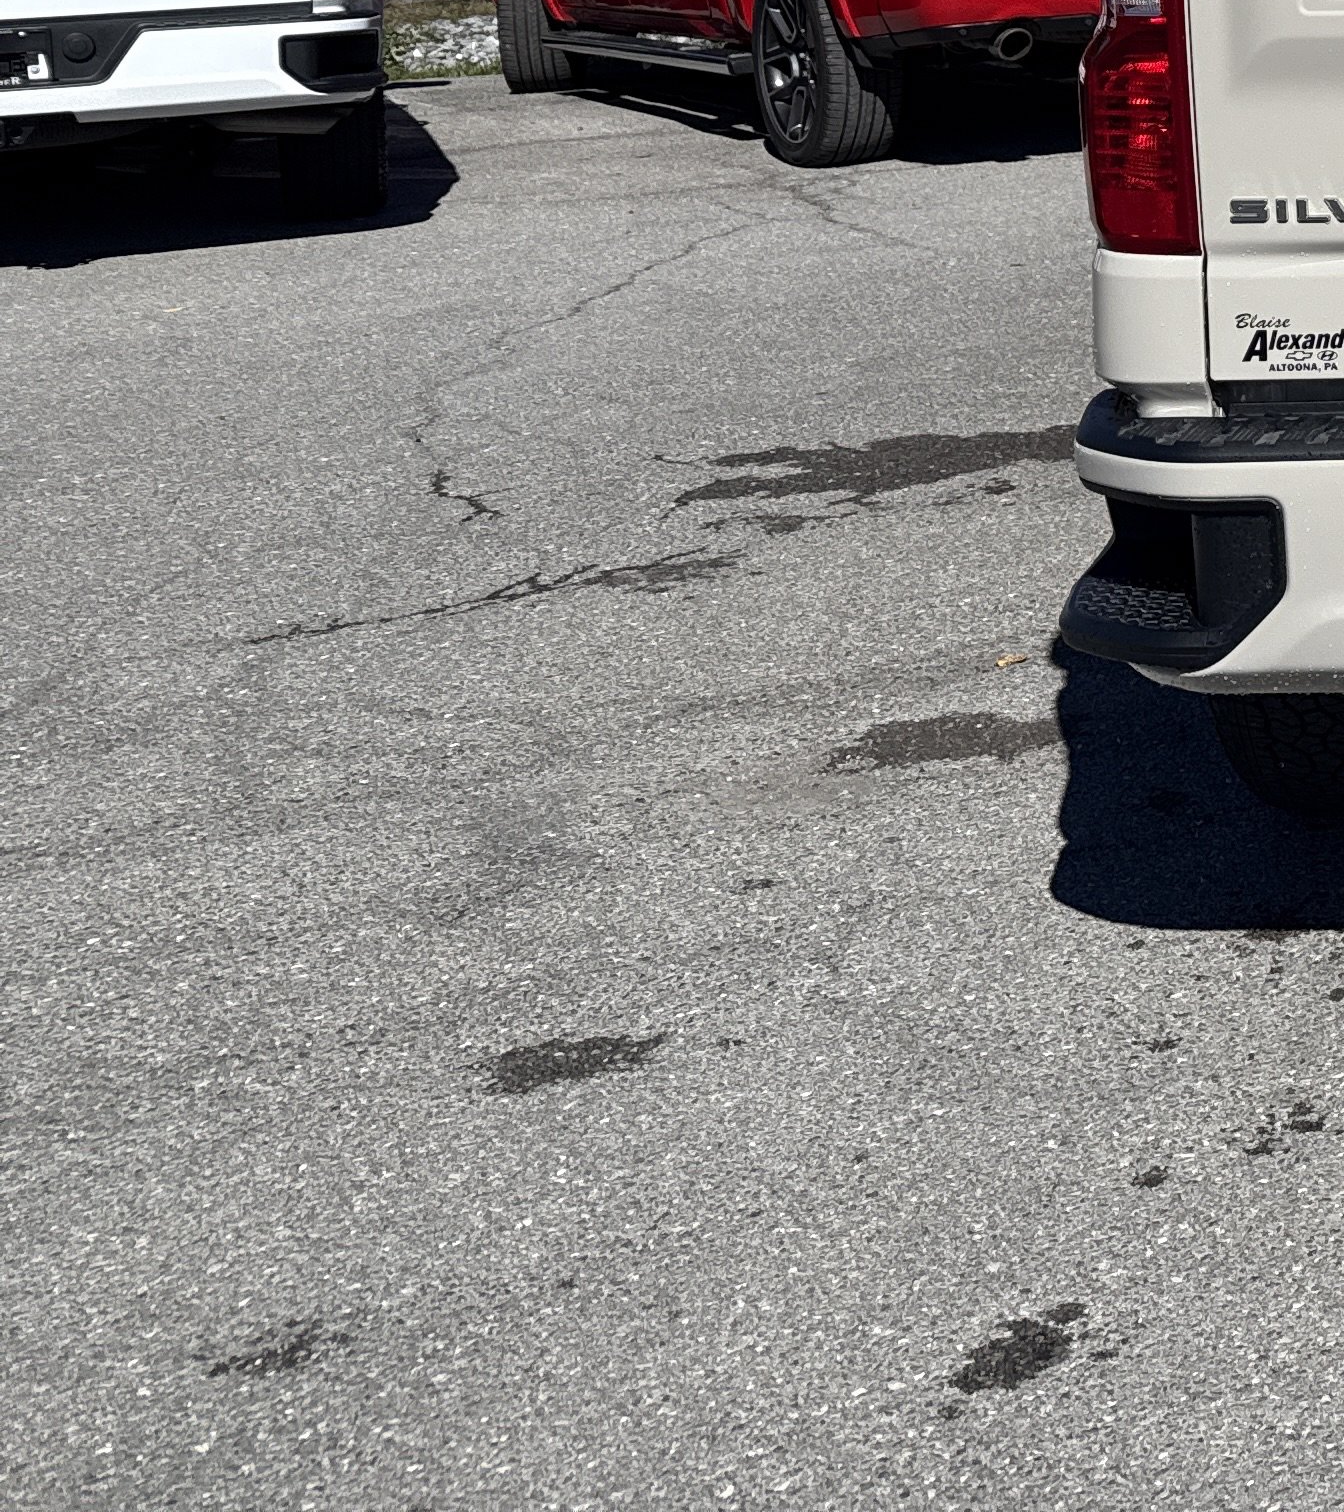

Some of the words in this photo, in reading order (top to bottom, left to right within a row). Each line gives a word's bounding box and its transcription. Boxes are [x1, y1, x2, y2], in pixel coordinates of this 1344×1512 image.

[1234, 312, 1291, 329] Blaise
[1269, 362, 1322, 373] ALTOONA,
[1324, 362, 1338, 370] PA
